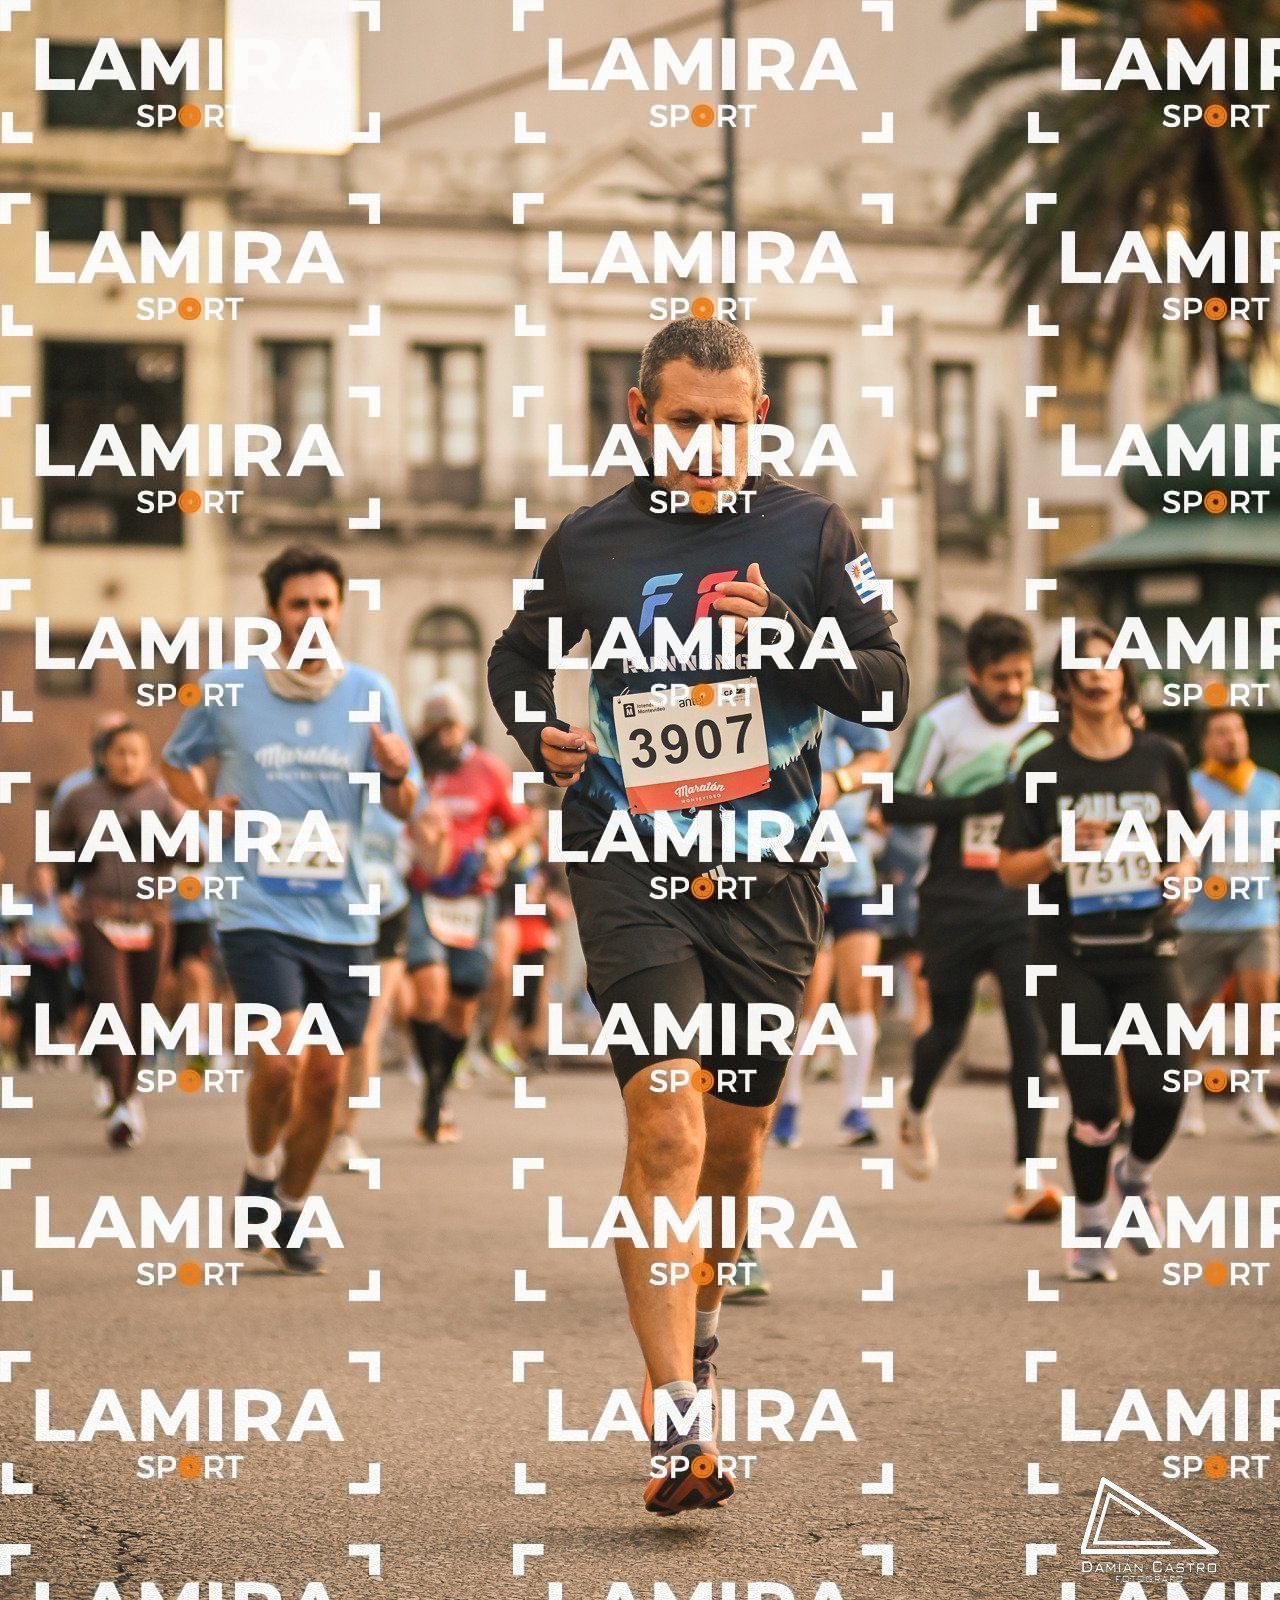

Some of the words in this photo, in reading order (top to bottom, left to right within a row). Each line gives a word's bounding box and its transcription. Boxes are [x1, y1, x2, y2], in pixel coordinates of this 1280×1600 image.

[623, 652, 753, 675] RNNNG
[678, 691, 705, 708] ant
[628, 712, 753, 769] 3907
[674, 781, 726, 799] Maratón
[680, 793, 722, 804] MONTEVIDEO
[1076, 855, 1151, 886] 7519
